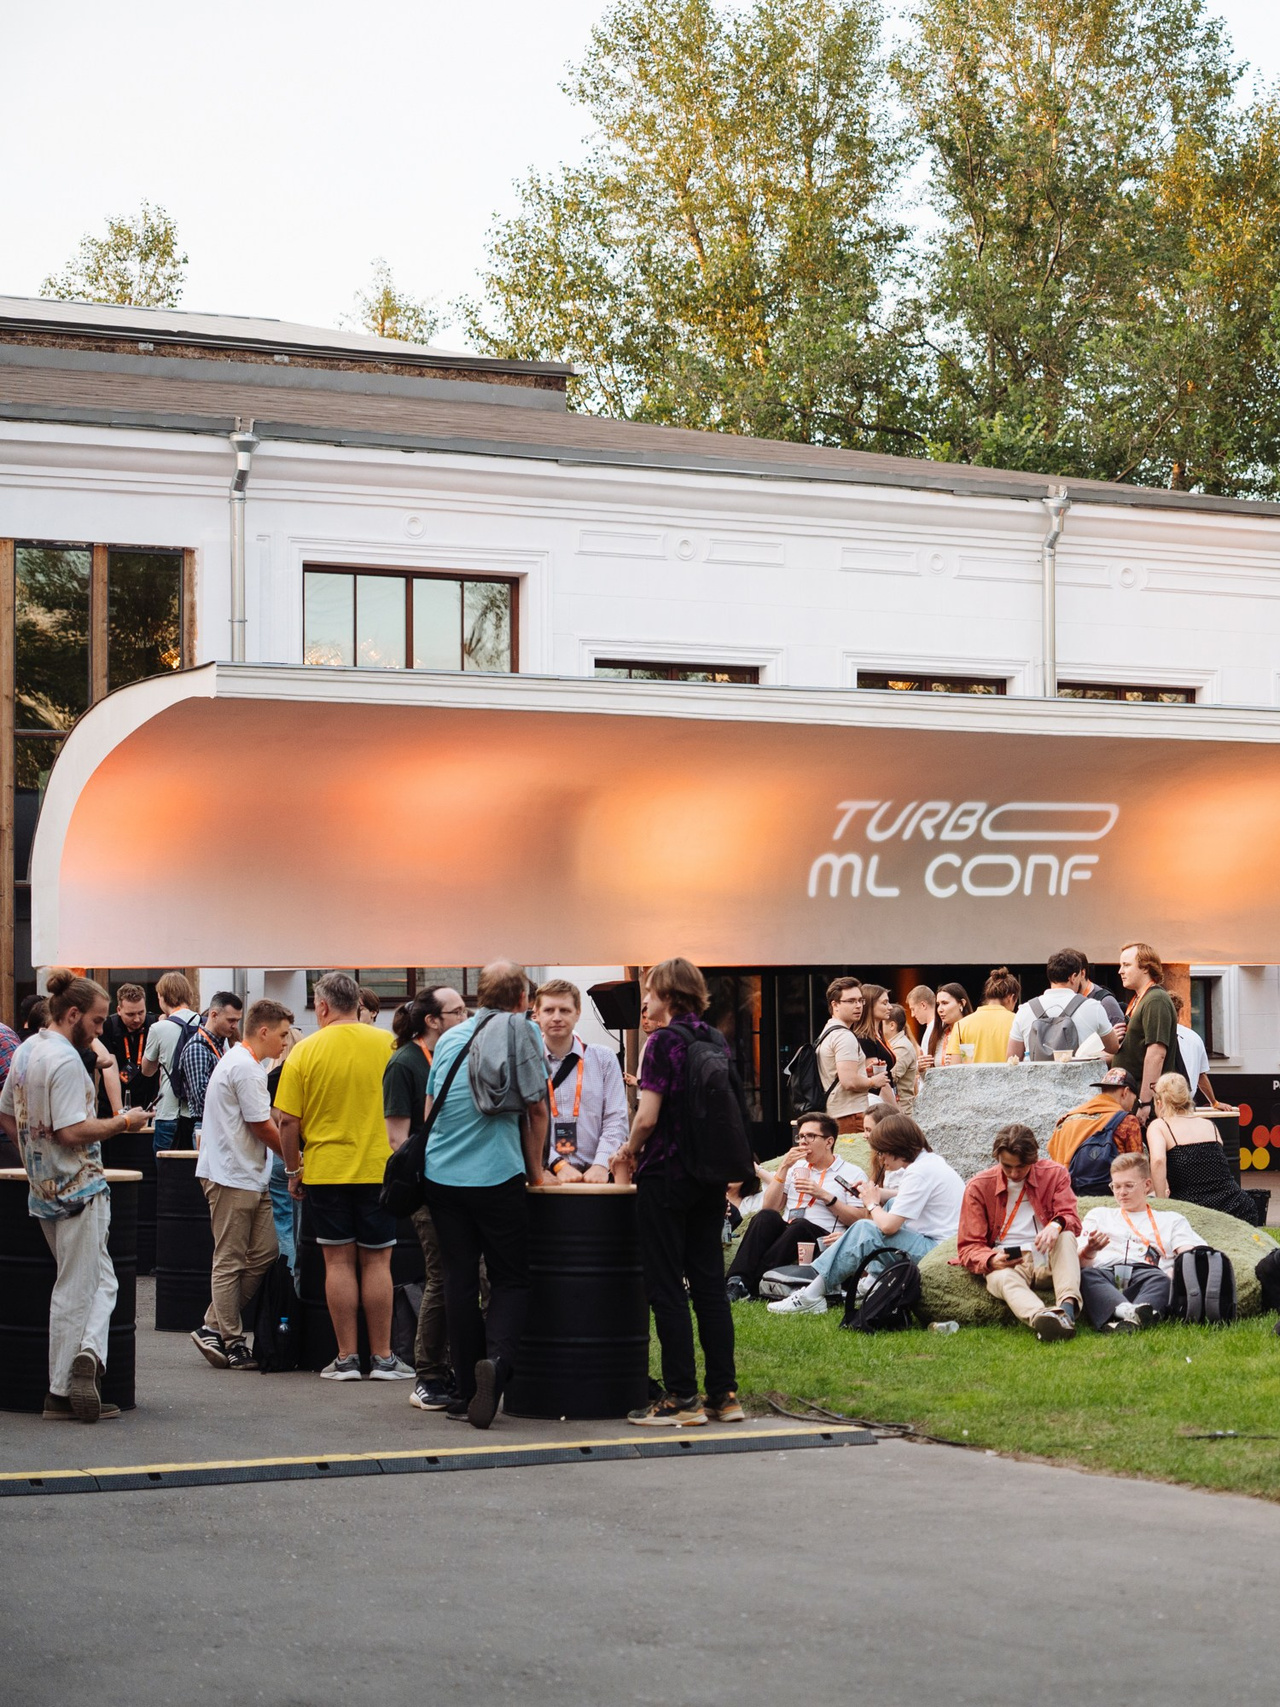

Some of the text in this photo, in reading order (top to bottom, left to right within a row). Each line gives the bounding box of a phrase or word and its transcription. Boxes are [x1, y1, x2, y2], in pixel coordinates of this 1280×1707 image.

[832, 800, 1120, 842] TURBO
[808, 853, 1099, 898] ML CONF
